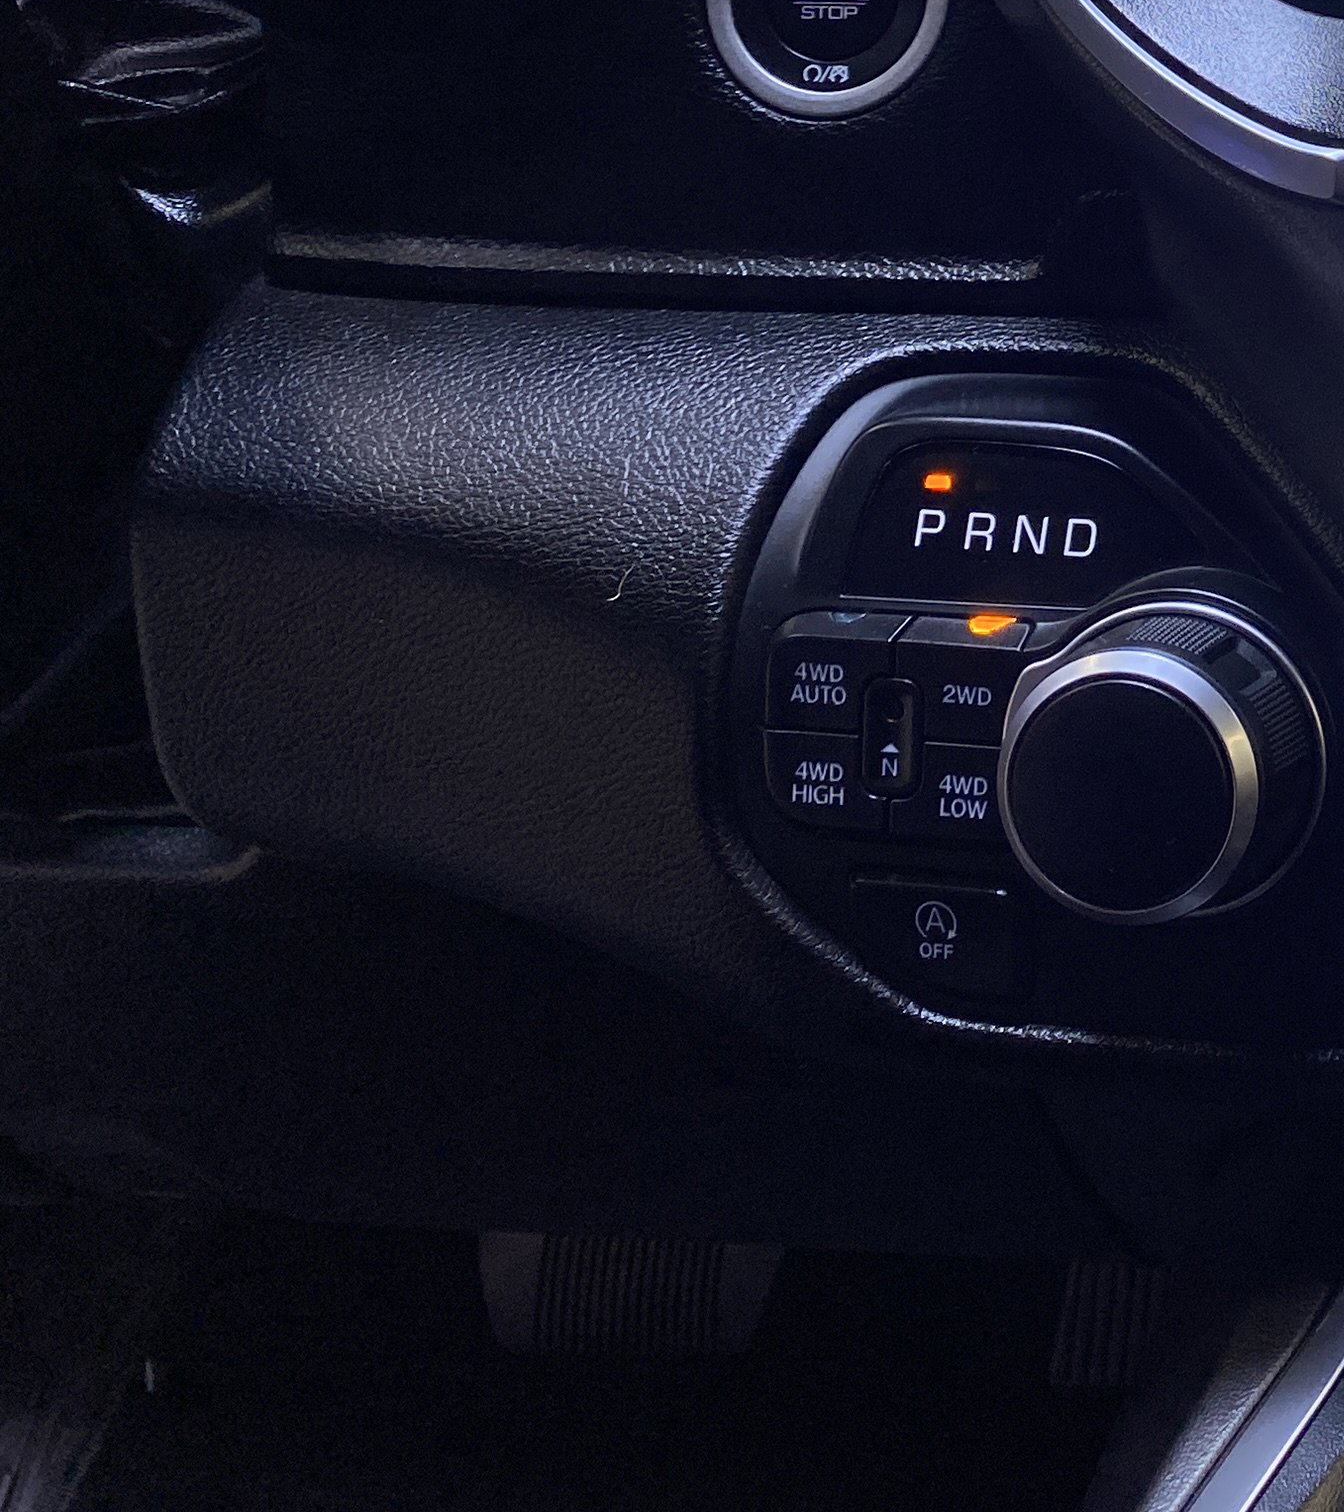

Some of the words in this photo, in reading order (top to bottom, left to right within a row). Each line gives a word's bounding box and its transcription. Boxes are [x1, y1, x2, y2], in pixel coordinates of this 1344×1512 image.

[801, 5, 859, 21] STOP
[795, 661, 845, 684] 4WD
[790, 684, 848, 706] AUTO
[942, 684, 992, 706] 2WD
[794, 761, 845, 784] 4WD
[881, 757, 898, 777] N
[791, 783, 845, 806] HIGH
[938, 774, 988, 796] 4WD
[939, 797, 988, 820] LOW
[919, 941, 954, 960] OFF
